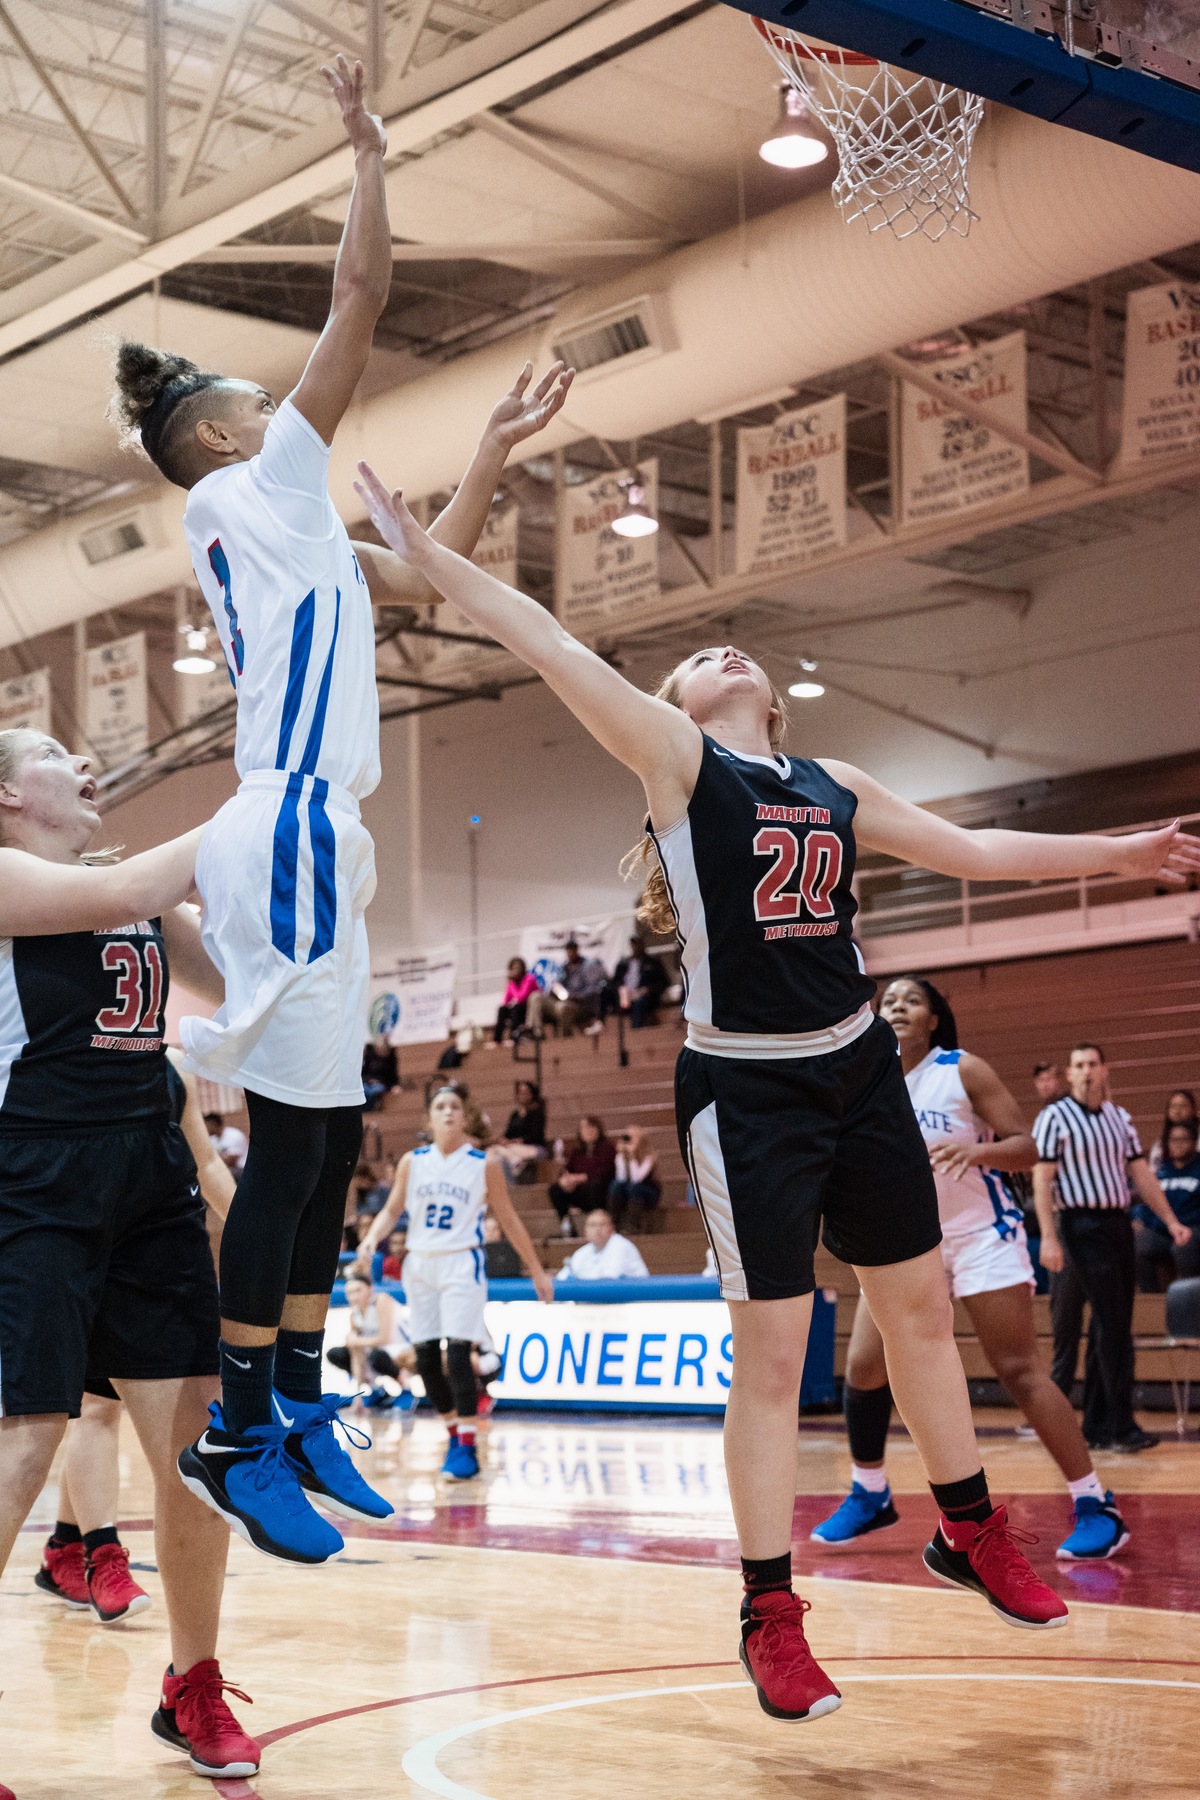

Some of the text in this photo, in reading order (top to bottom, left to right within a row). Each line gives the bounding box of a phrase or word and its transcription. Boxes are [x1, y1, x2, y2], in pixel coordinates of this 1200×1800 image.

[754, 802, 831, 825] MARTIN
[753, 827, 843, 922] 20
[763, 921, 840, 941] METHODIST
[95, 941, 163, 1033] 31
[90, 1034, 163, 1052] METHODIST
[426, 1203, 454, 1230] 22
[497, 1331, 733, 1390] IONEERS
